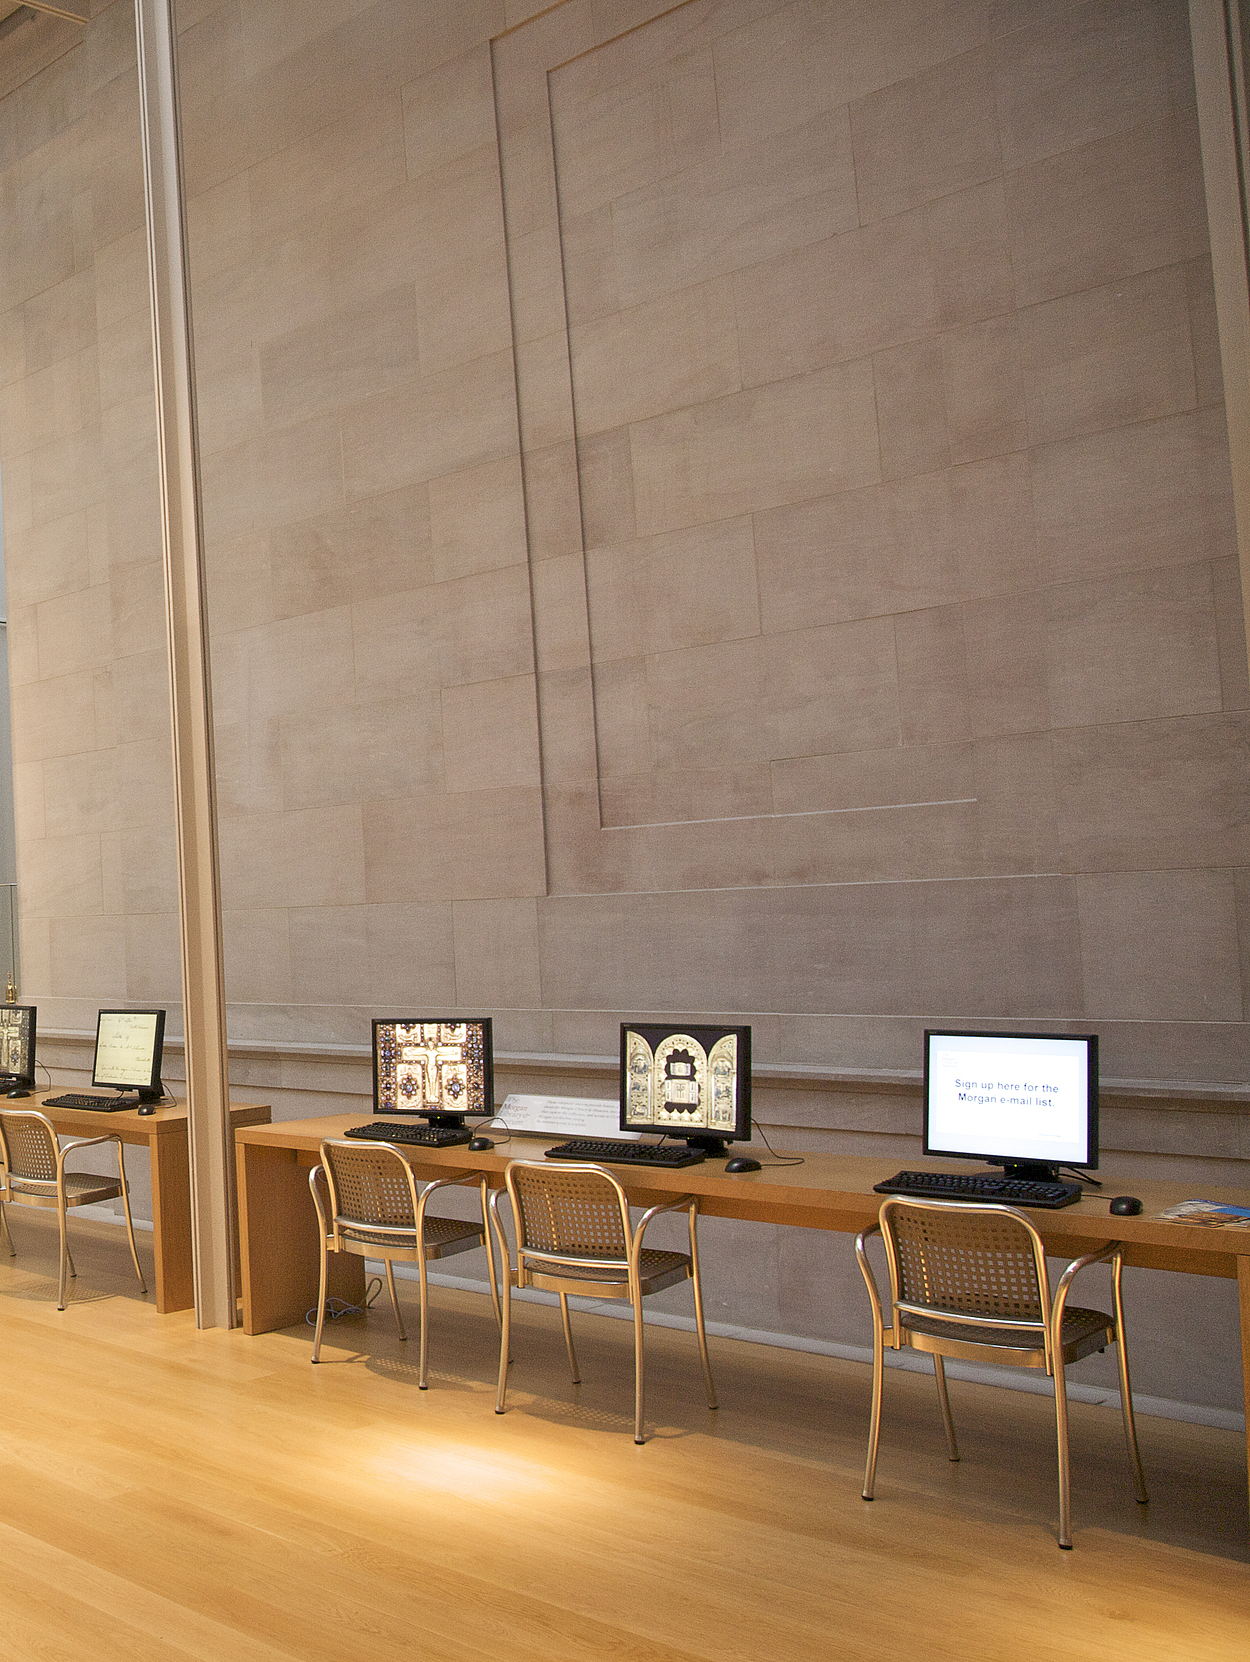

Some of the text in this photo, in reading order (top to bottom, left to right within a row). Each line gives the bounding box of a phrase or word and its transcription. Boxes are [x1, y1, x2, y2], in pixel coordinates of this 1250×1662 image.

[954, 1079, 1059, 1094] Sign up here for the
[958, 1093, 1055, 1107] Morgan e-mail list.
[502, 1103, 528, 1112] Morgan
